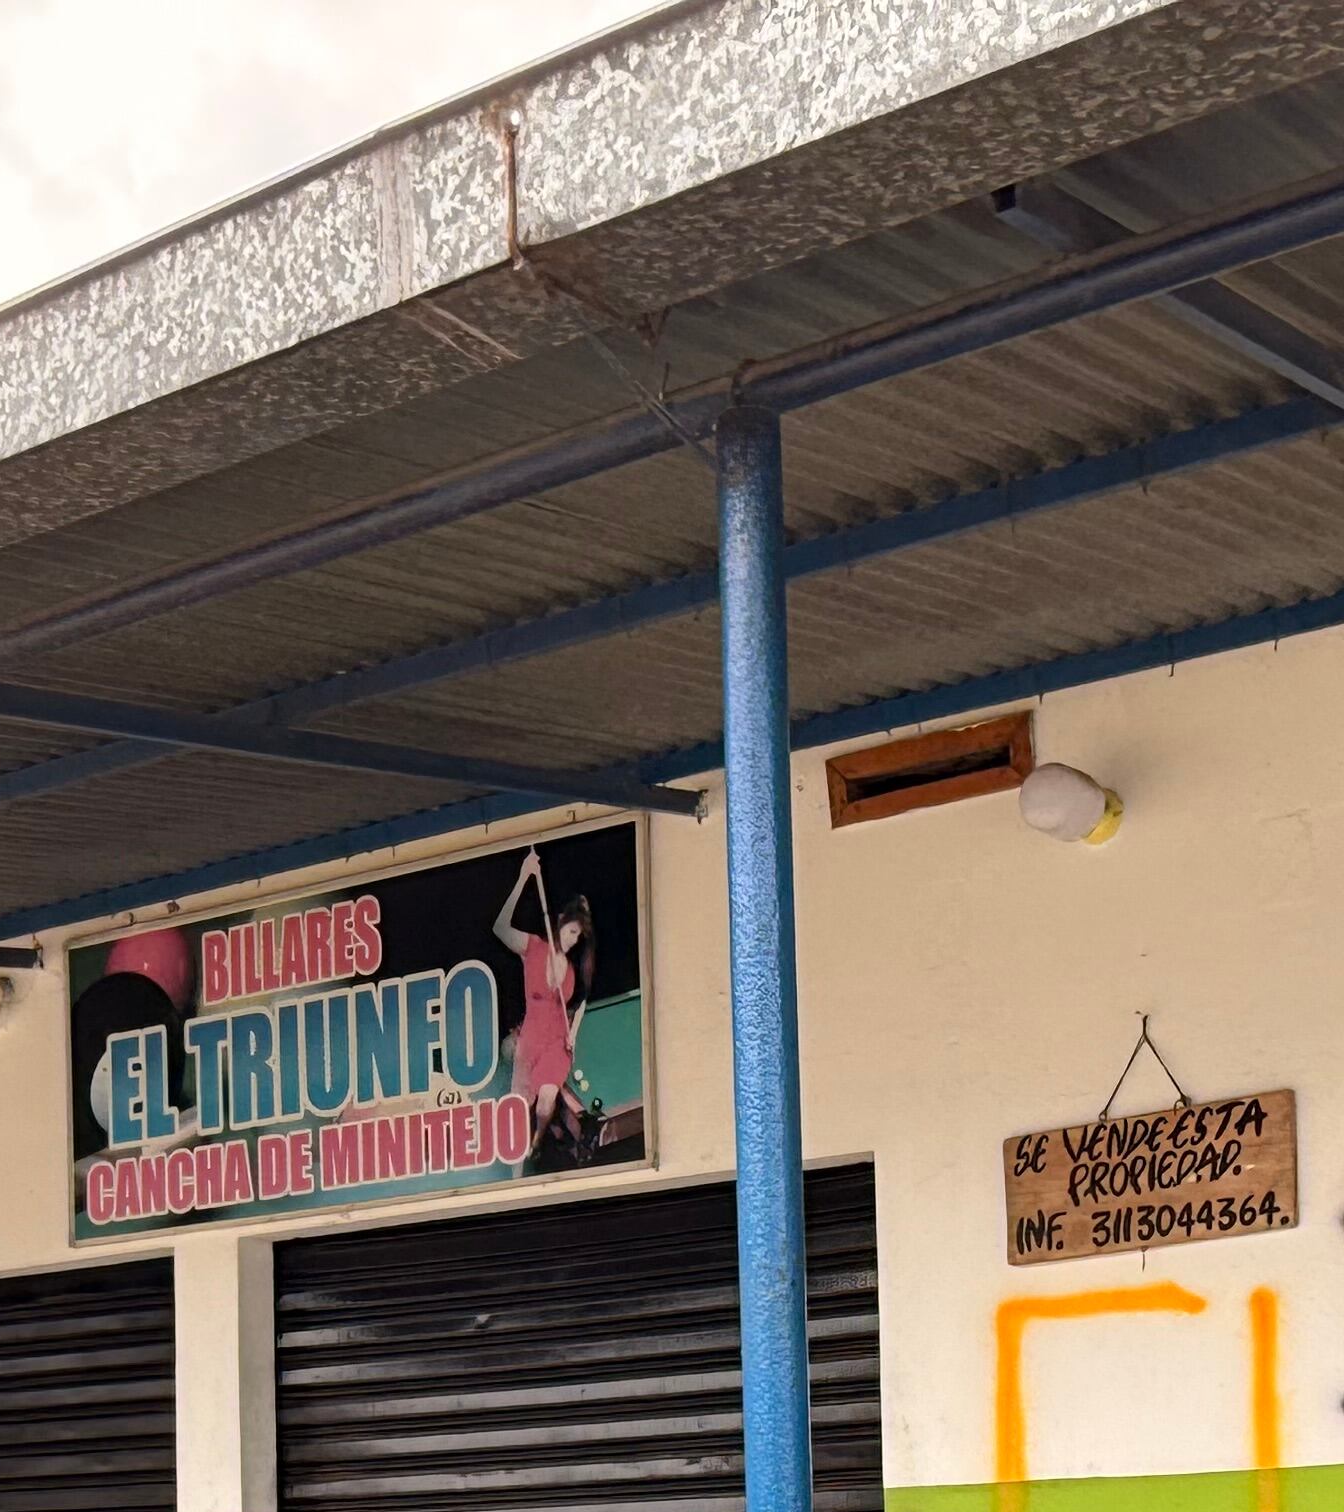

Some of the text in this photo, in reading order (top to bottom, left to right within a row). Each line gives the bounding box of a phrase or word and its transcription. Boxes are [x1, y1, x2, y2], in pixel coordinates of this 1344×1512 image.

[202, 895, 382, 1006] BILLARES
[105, 959, 500, 1150] EL TRIUNFO
[86, 1094, 532, 1226] CANCHA DE MINITEJO
[1014, 1134, 1049, 1177] SE
[1016, 1191, 1290, 1255] INF. 3113044364.
